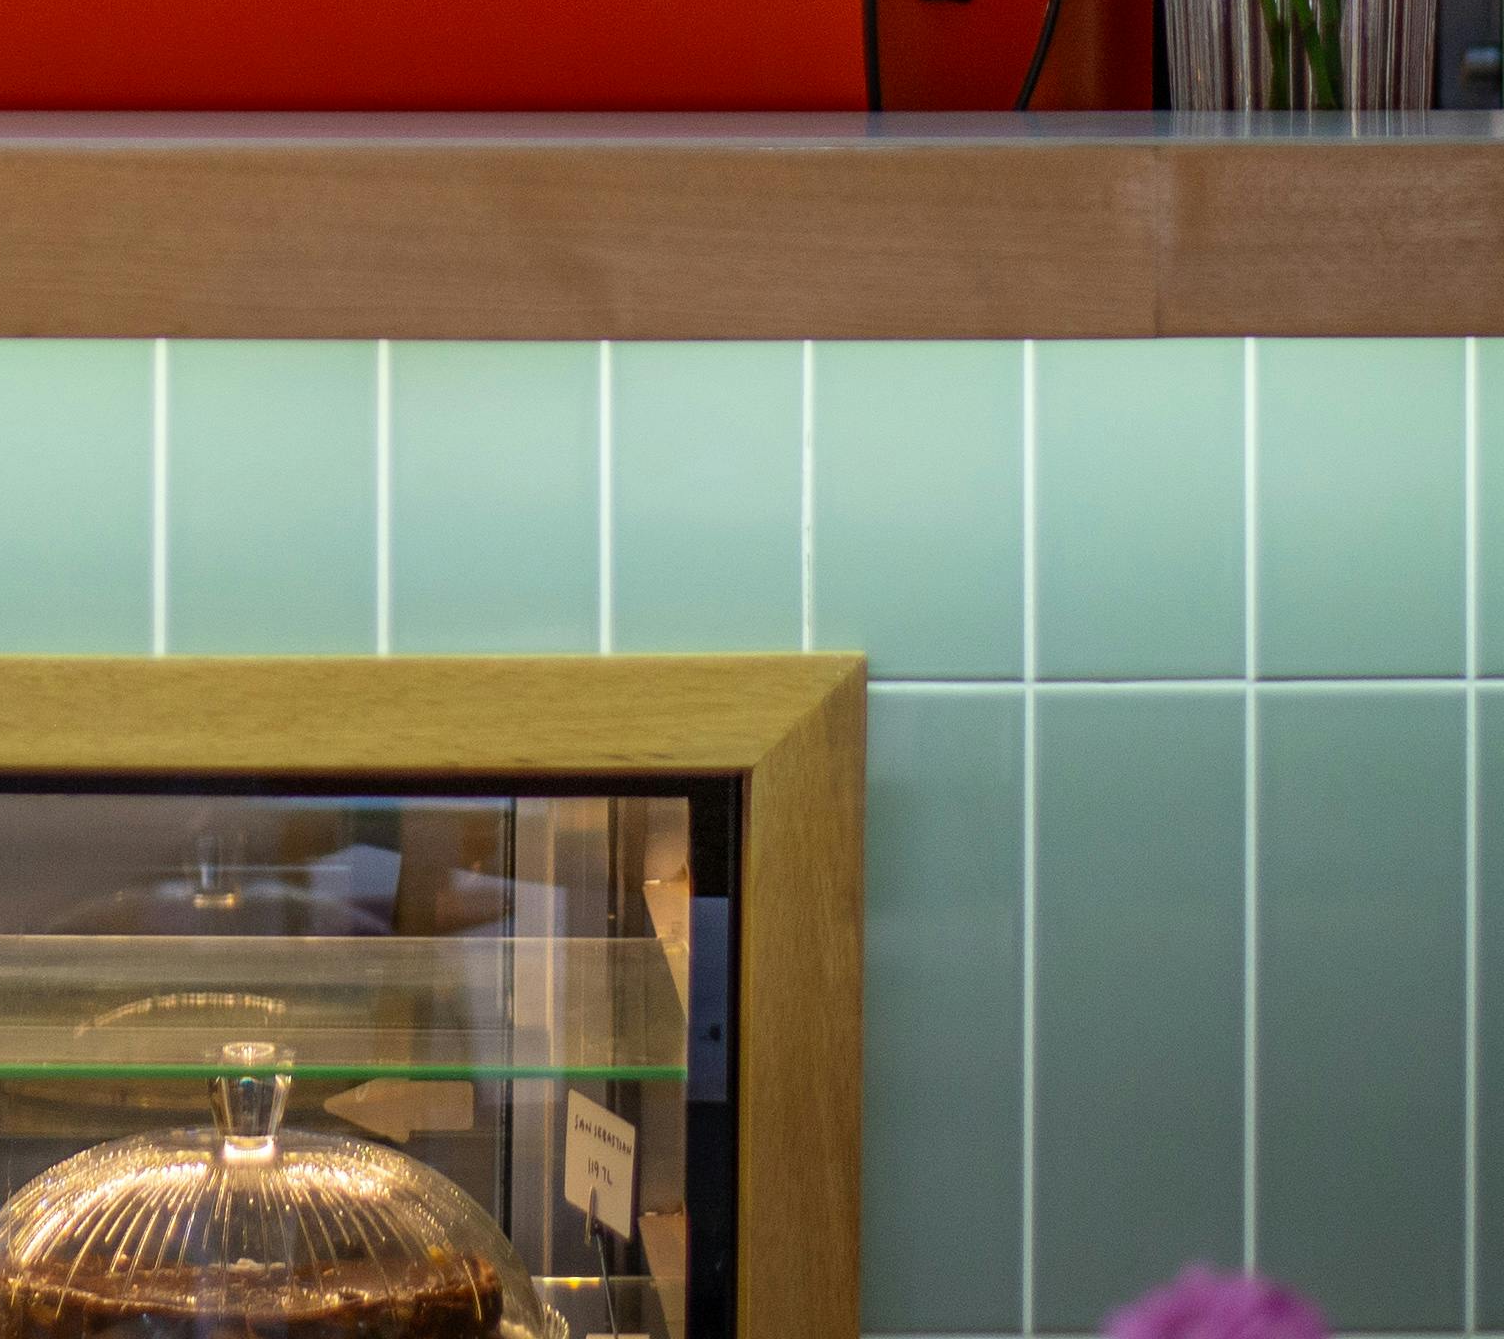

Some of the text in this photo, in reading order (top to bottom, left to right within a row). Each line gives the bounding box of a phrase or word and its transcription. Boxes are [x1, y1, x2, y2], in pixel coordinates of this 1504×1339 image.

[574, 1114, 632, 1156] SAN SEBASTIAN
[587, 1157, 613, 1186] 119 TL
